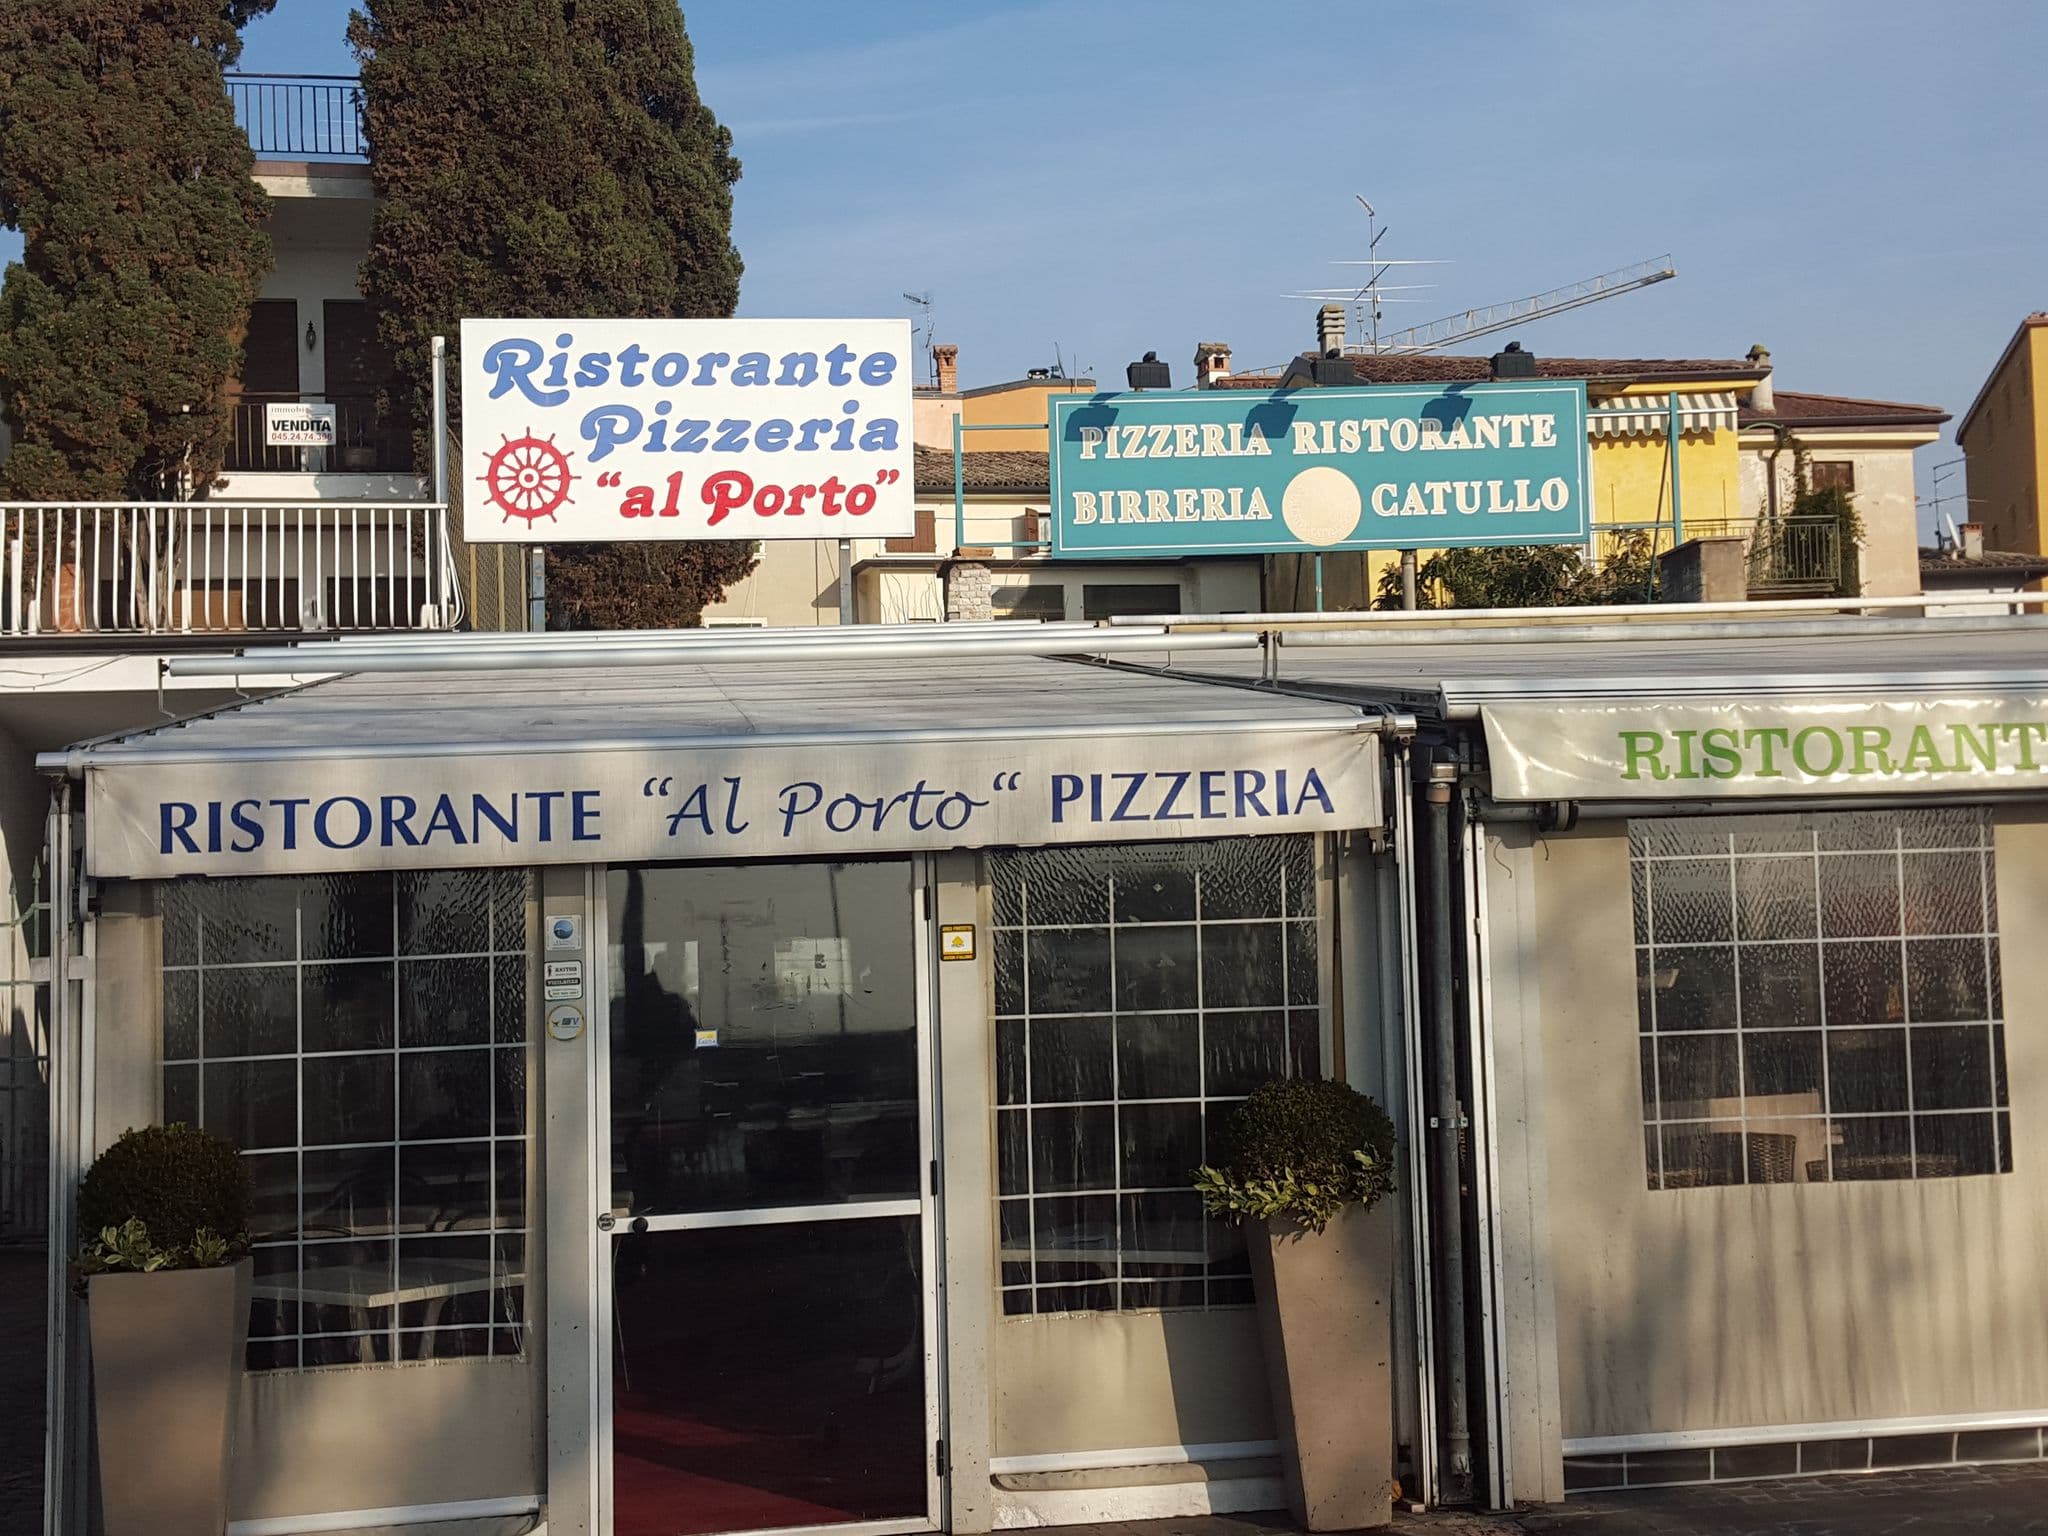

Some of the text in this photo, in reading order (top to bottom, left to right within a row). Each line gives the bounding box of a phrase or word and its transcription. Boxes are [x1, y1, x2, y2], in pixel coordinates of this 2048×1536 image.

[482, 333, 898, 407] Ristorante
[271, 419, 332, 432] VENDITA
[579, 400, 899, 462] Pizzeria
[1079, 413, 1558, 460] PIZZERIA RISTORANTE
[1072, 486, 1273, 525] BIRRERIA
[1371, 476, 1570, 517] CATULLO
[160, 790, 601, 854] RISTORANTE
[1050, 768, 1335, 824] PIZZERIA
